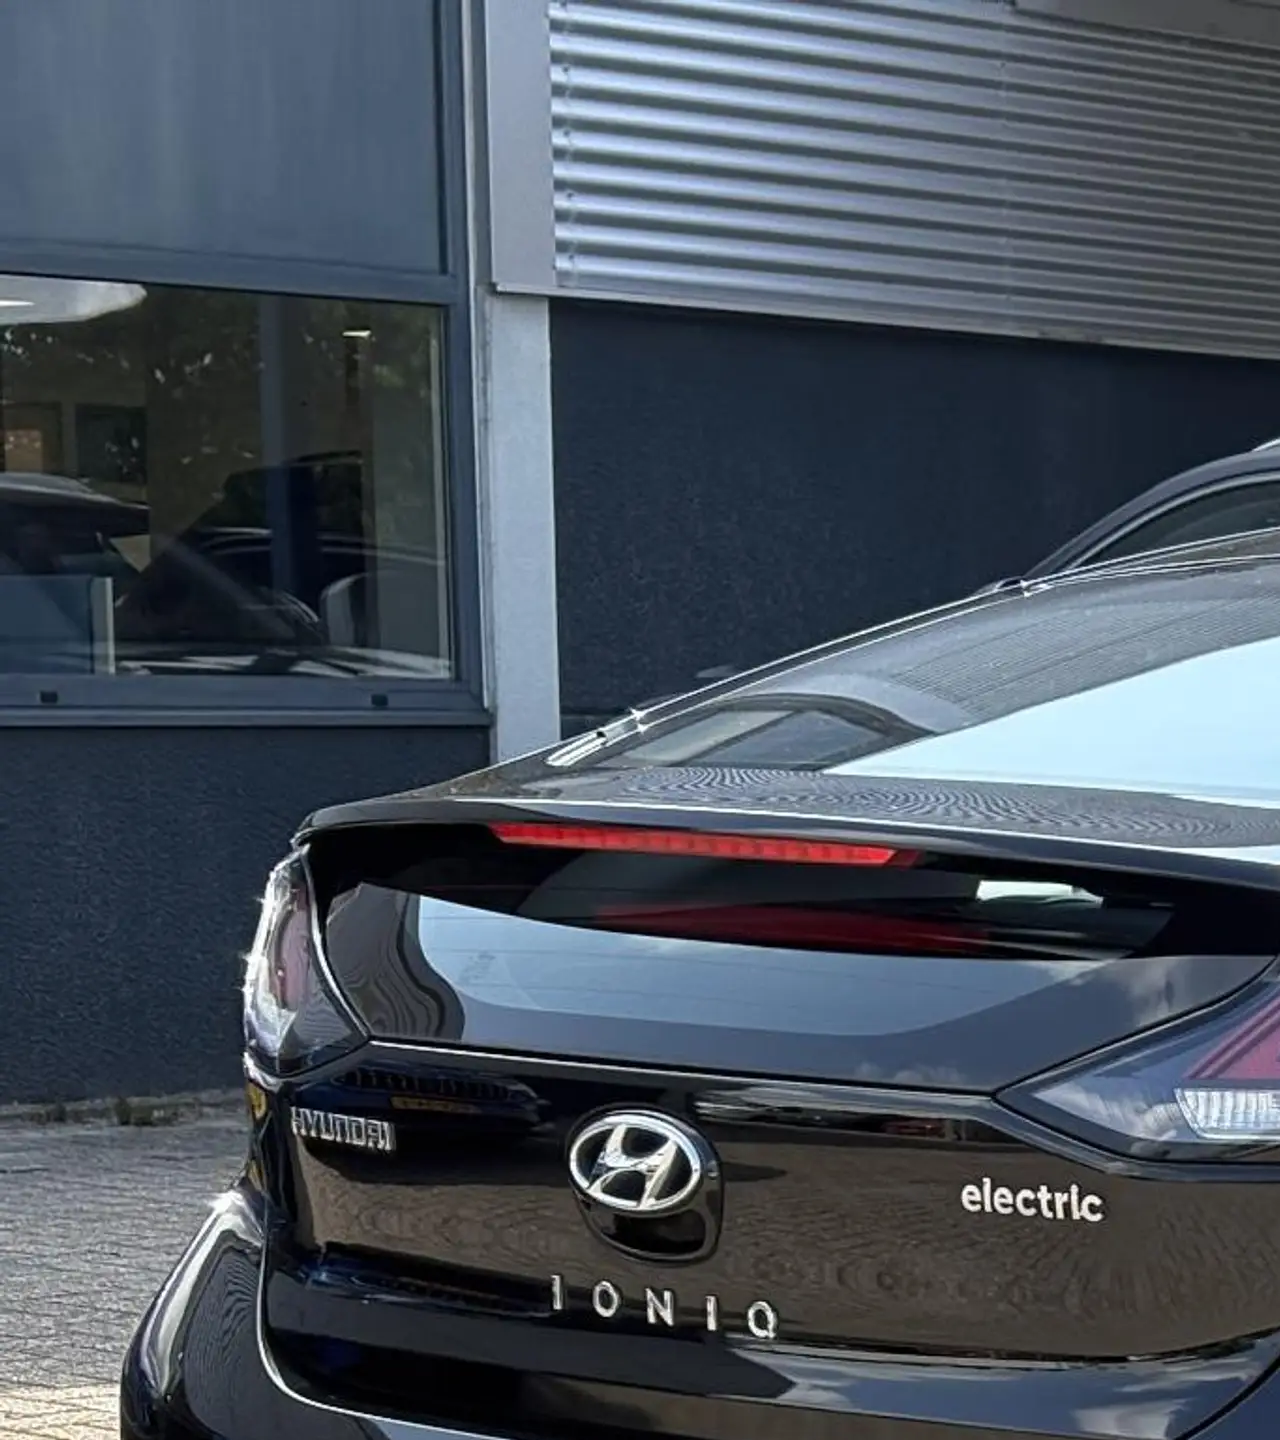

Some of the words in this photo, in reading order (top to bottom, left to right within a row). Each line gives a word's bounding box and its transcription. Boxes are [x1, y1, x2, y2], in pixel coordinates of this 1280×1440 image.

[289, 1105, 394, 1152] HYUNDAI
[960, 1177, 1104, 1222] electric
[550, 1274, 778, 1340] IONIQ
